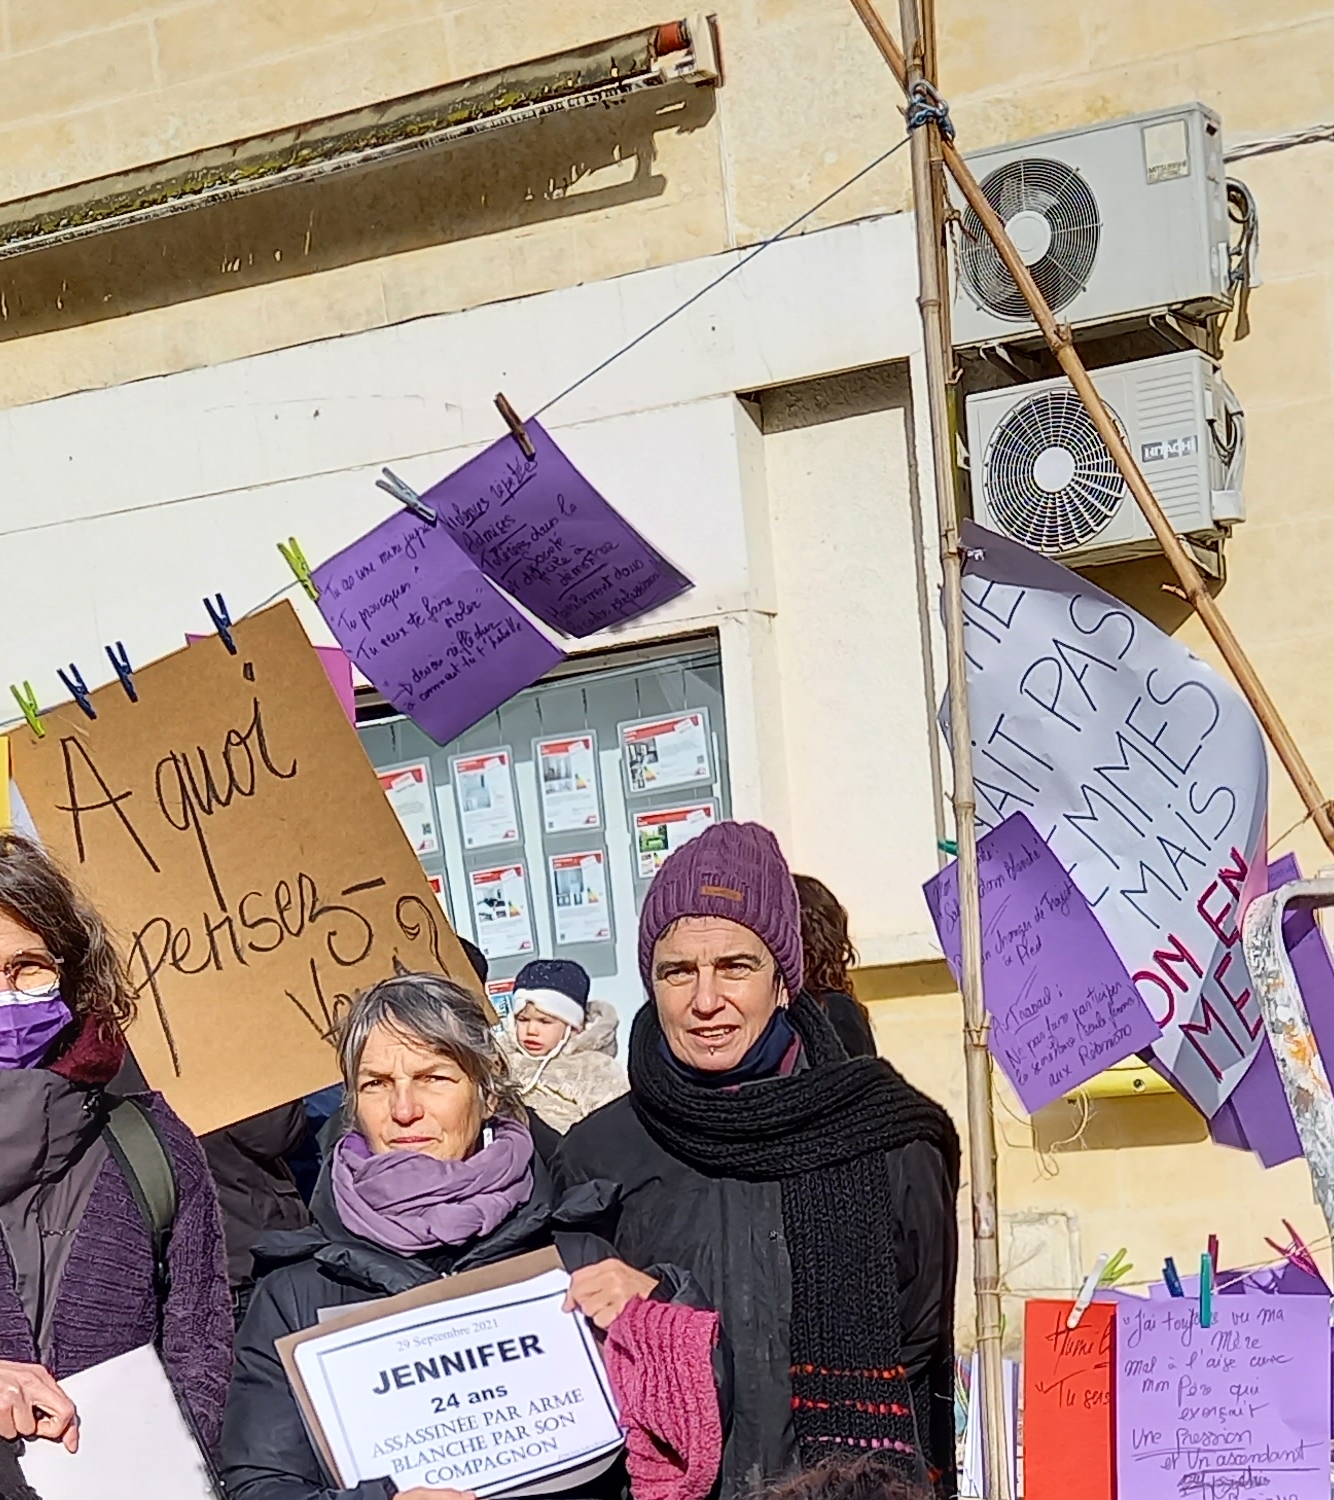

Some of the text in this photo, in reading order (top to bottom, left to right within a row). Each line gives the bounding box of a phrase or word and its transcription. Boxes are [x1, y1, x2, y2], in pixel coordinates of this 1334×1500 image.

[1144, 435, 1196, 459] HITACHI
[1019, 593, 1135, 733] PAS
[54, 735, 160, 873] A
[155, 662, 297, 914] quoi
[1196, 846, 1249, 949] EN
[372, 1333, 546, 1395] JENNIFER
[396, 1318, 499, 1351] 29 Septembre 2021
[371, 1387, 585, 1458] ASSASSINÉE PAR ARME
[430, 1384, 508, 1414] 24 ans
[391, 1411, 577, 1475] BLANCHE PAR SON
[424, 1436, 559, 1486] COMPAGNON
[1216, 1438, 1325, 1468] ascendant
